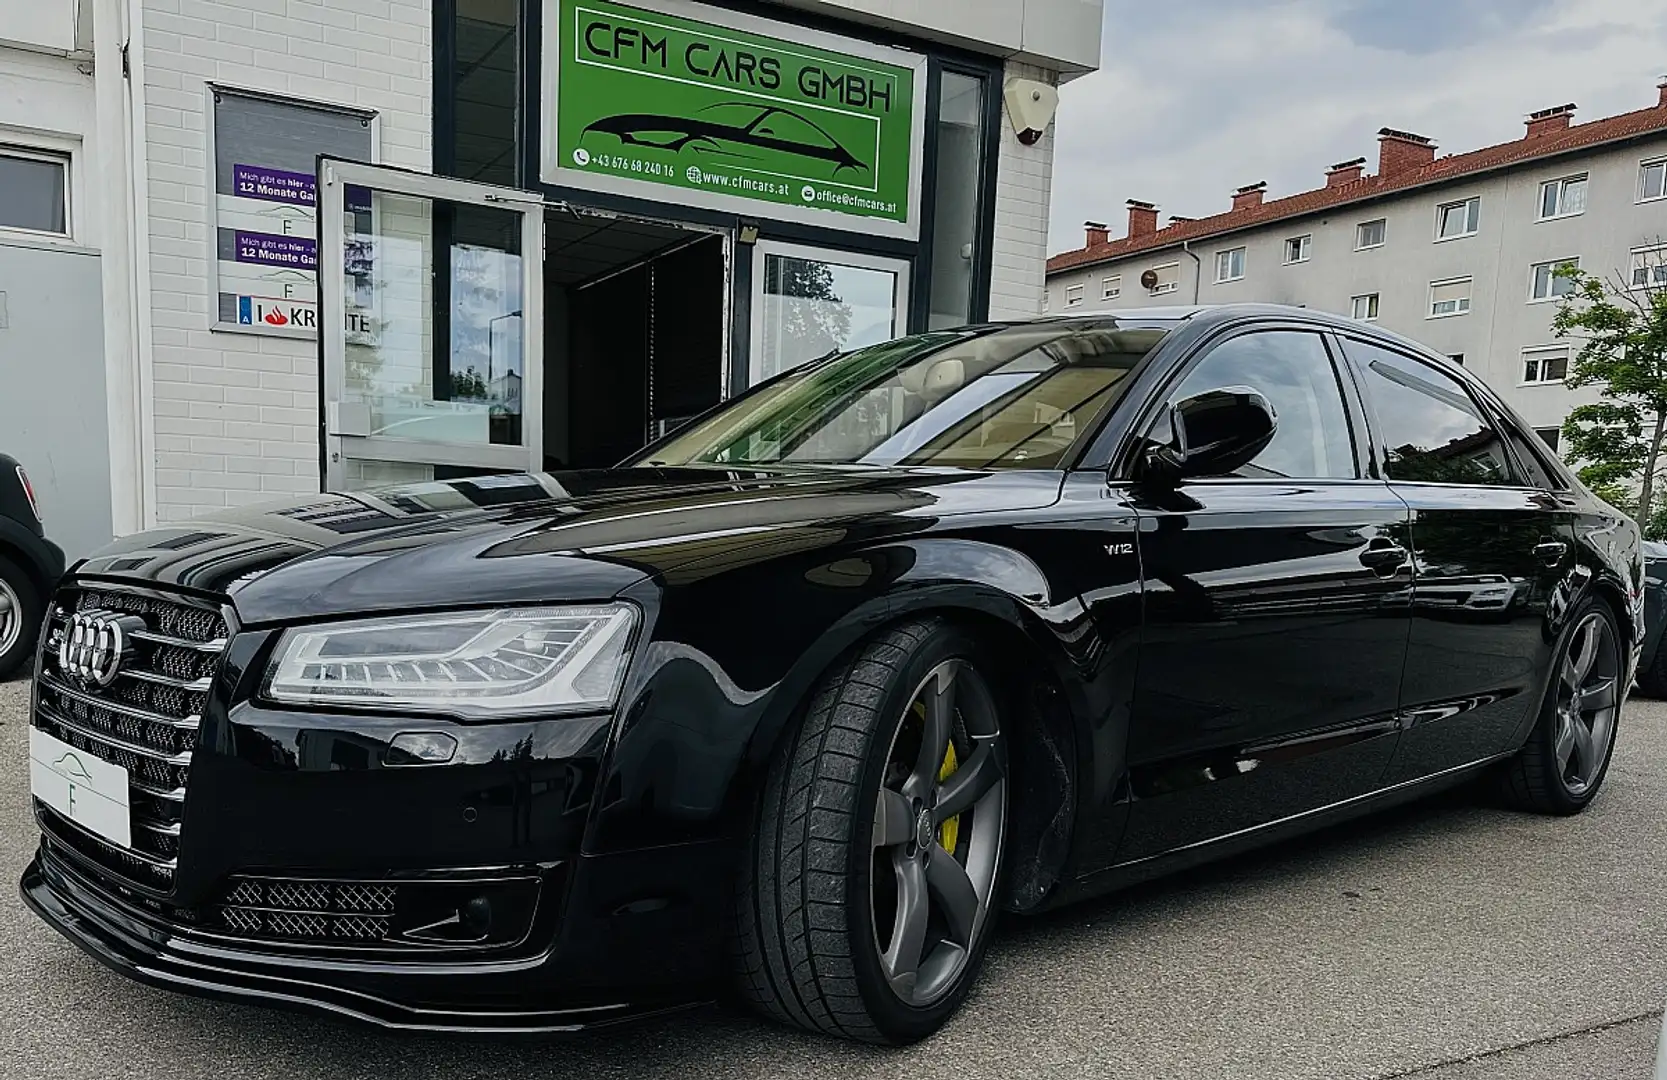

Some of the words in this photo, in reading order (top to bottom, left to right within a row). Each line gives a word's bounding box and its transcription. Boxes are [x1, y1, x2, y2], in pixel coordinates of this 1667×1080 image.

[584, 21, 667, 69] CFM
[684, 42, 781, 90] CARS
[798, 66, 890, 113] GMBH
[592, 154, 610, 167] +43
[612, 157, 628, 170] 676
[631, 160, 643, 173] 68
[645, 164, 662, 176] 240
[664, 165, 674, 178] 16
[240, 172, 259, 181] Mich
[260, 176, 275, 185] gibt
[288, 179, 303, 188] hier
[703, 171, 789, 196] www.cfmcars.at
[240, 182, 254, 193] 12
[257, 184, 297, 199] Monate
[817, 190, 897, 213] office@cfmcars.at
[241, 237, 260, 246] Mich
[262, 240, 276, 249] gibt
[289, 243, 304, 252] hier
[241, 247, 256, 258] 12
[258, 249, 299, 263] Monate
[243, 315, 250, 324] A
[1103, 543, 1134, 556] W12
